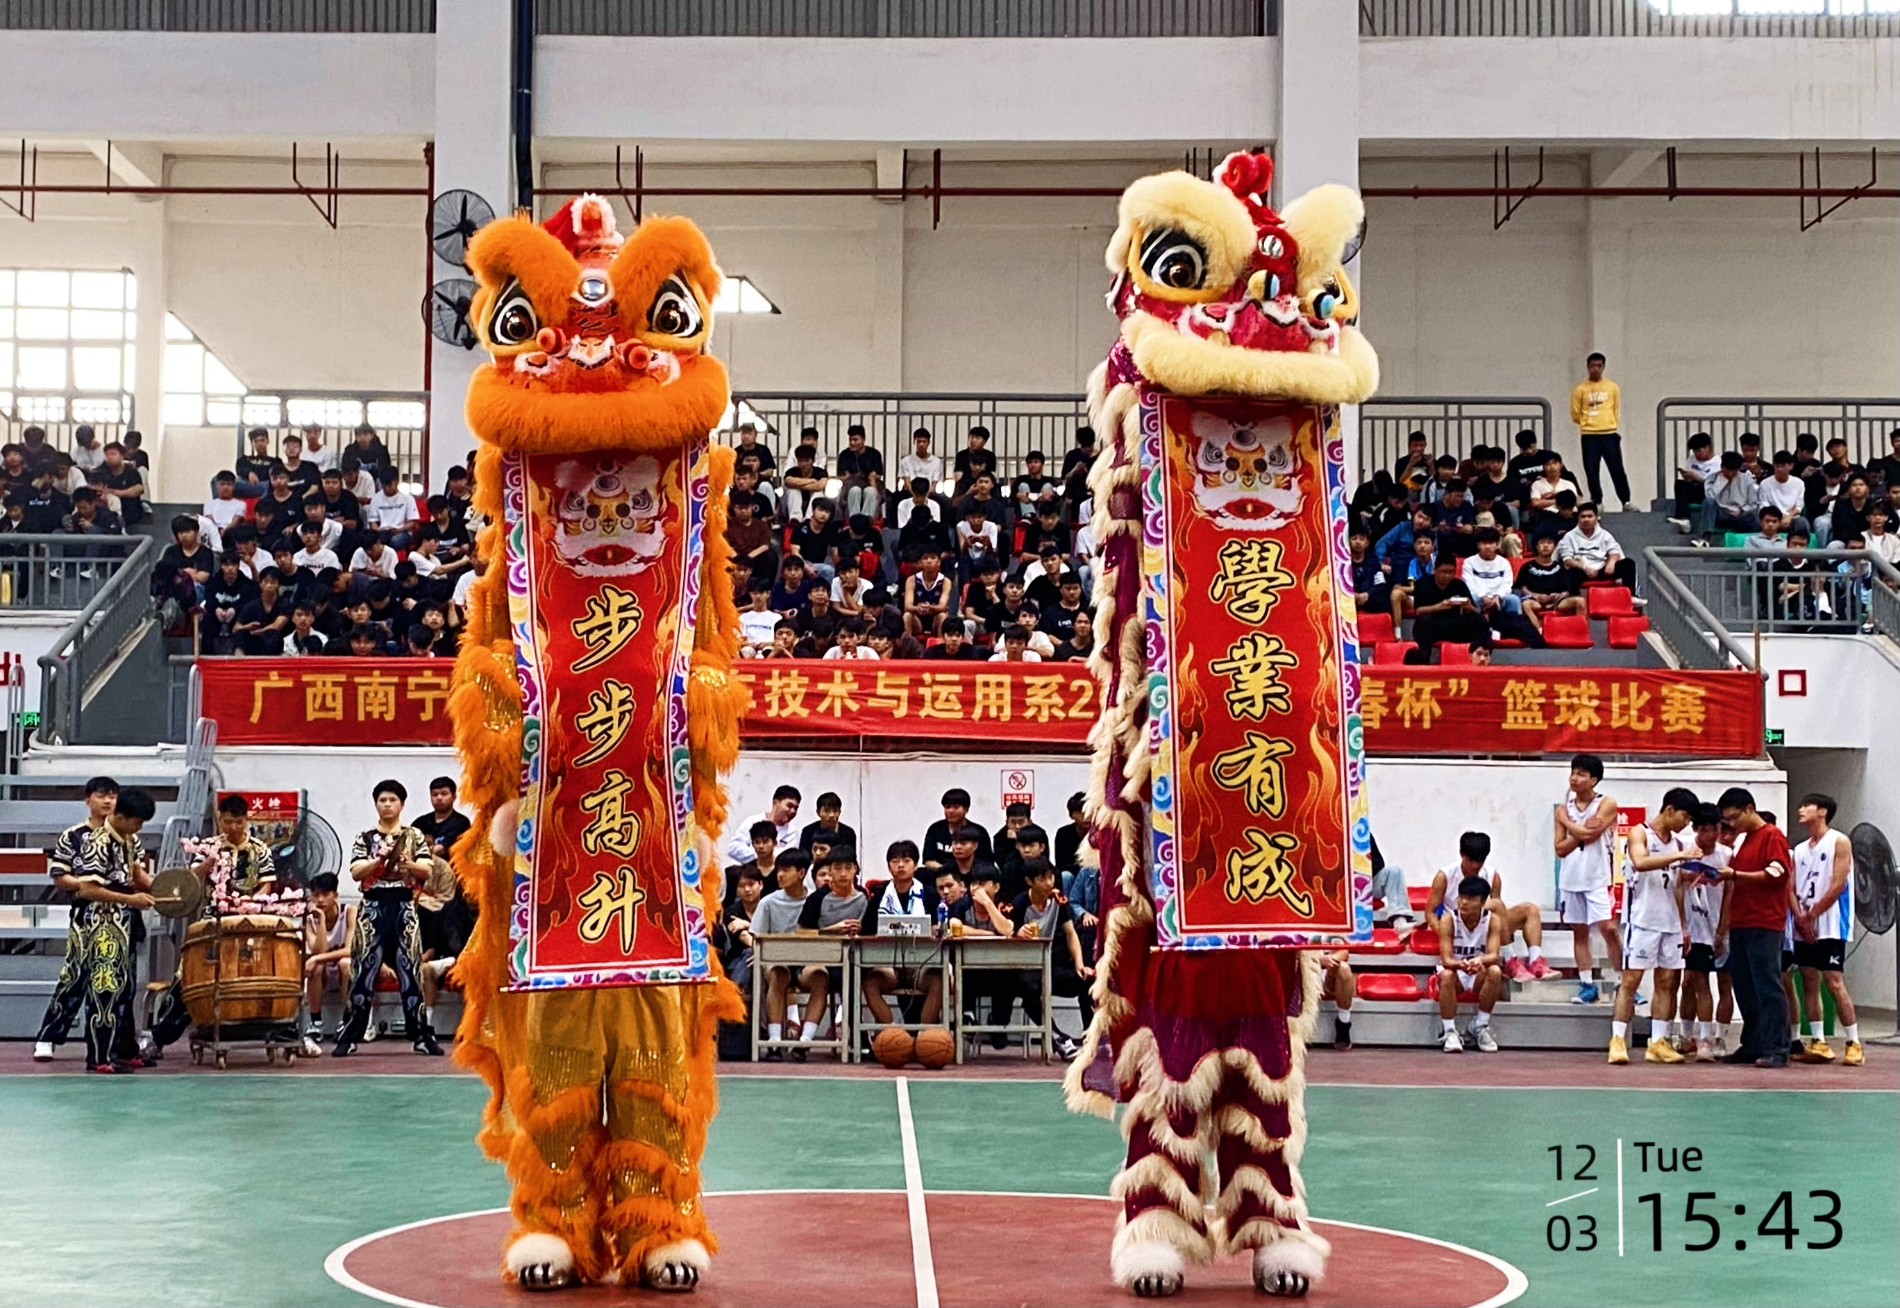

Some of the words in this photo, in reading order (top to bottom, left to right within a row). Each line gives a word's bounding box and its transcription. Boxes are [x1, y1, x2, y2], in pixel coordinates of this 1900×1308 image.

[250, 670, 449, 723] 广西南宁
[572, 584, 644, 955] 步步高升
[1208, 539, 1314, 917] 學業有成
